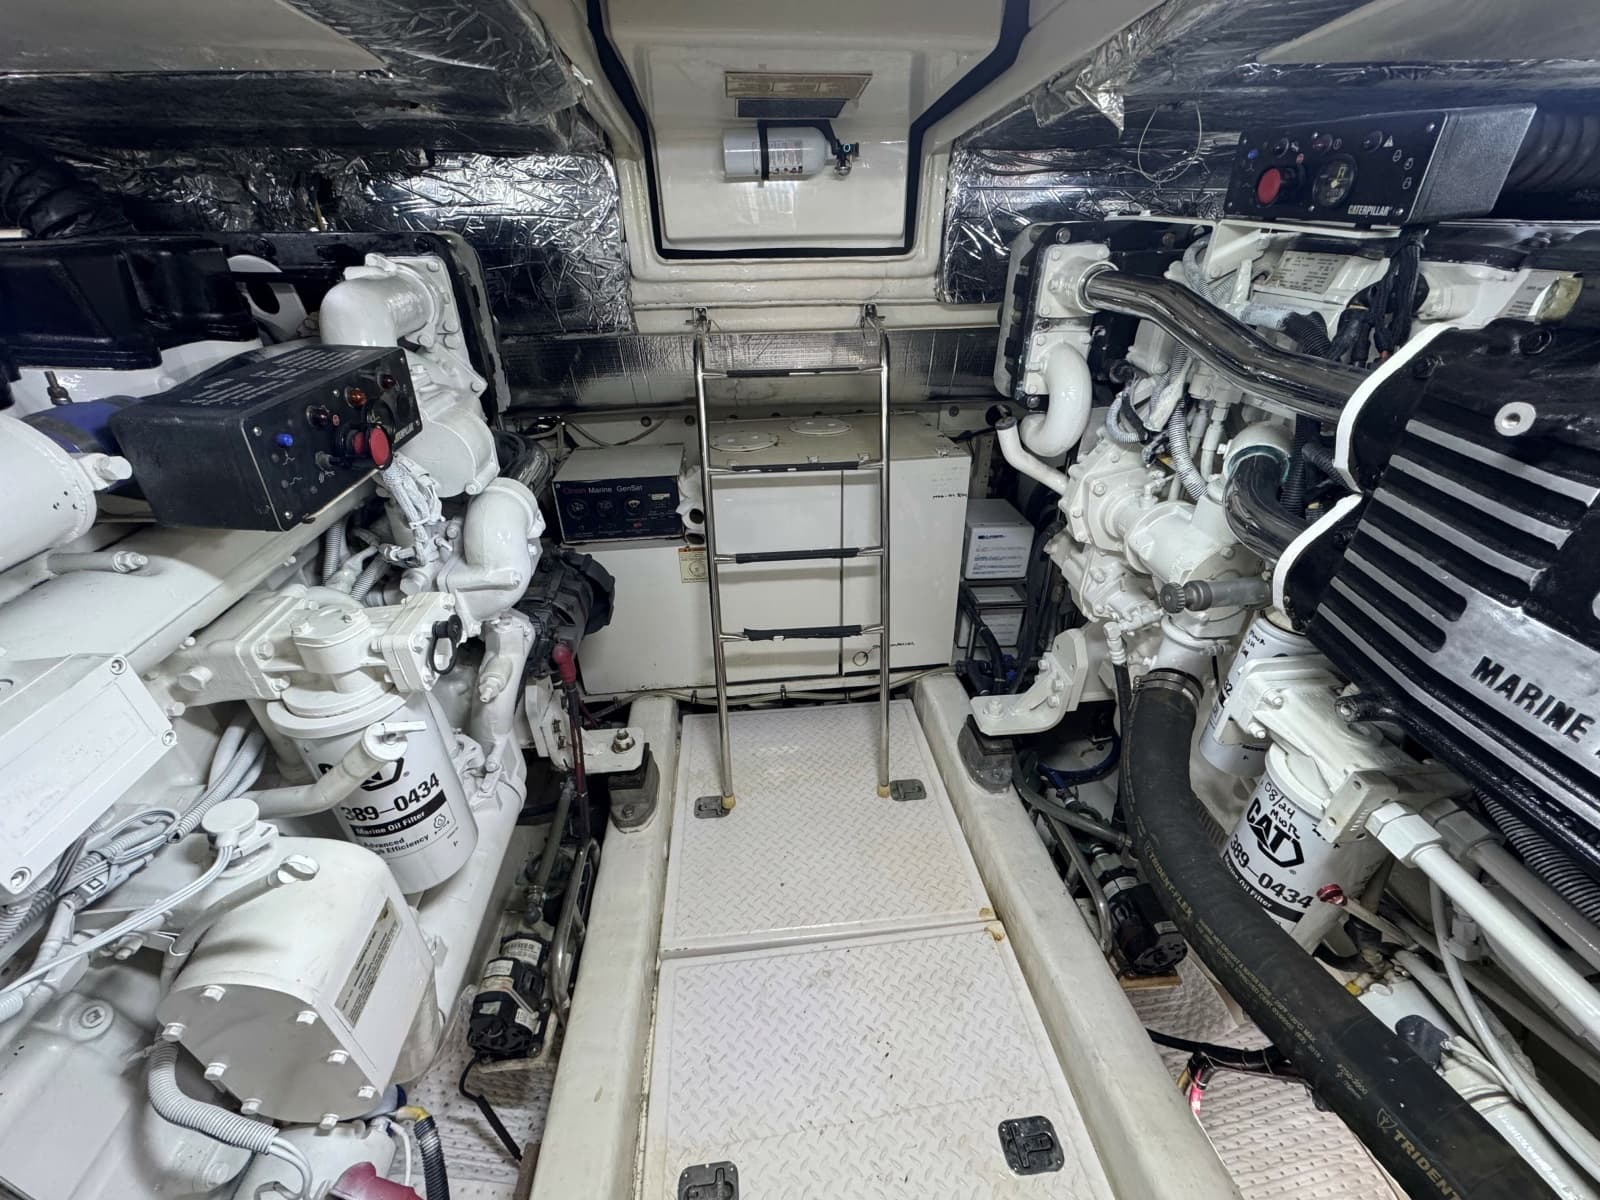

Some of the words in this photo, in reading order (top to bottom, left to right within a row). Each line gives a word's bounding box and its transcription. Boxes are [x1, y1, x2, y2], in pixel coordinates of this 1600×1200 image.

[1348, 204, 1391, 217] CATERPILLAR
[588, 486, 613, 494] Marine
[616, 484, 643, 493] GenSet
[1471, 655, 1596, 744] MARINE
[1264, 781, 1296, 819] 08/24
[355, 826, 387, 836] Marine
[387, 821, 402, 832] Oil
[403, 811, 426, 827] Filter
[1246, 797, 1292, 855] CAT
[386, 834, 430, 854] Efficiency
[1230, 833, 1315, 910] 389-0434
[1250, 890, 1273, 908] Filter
